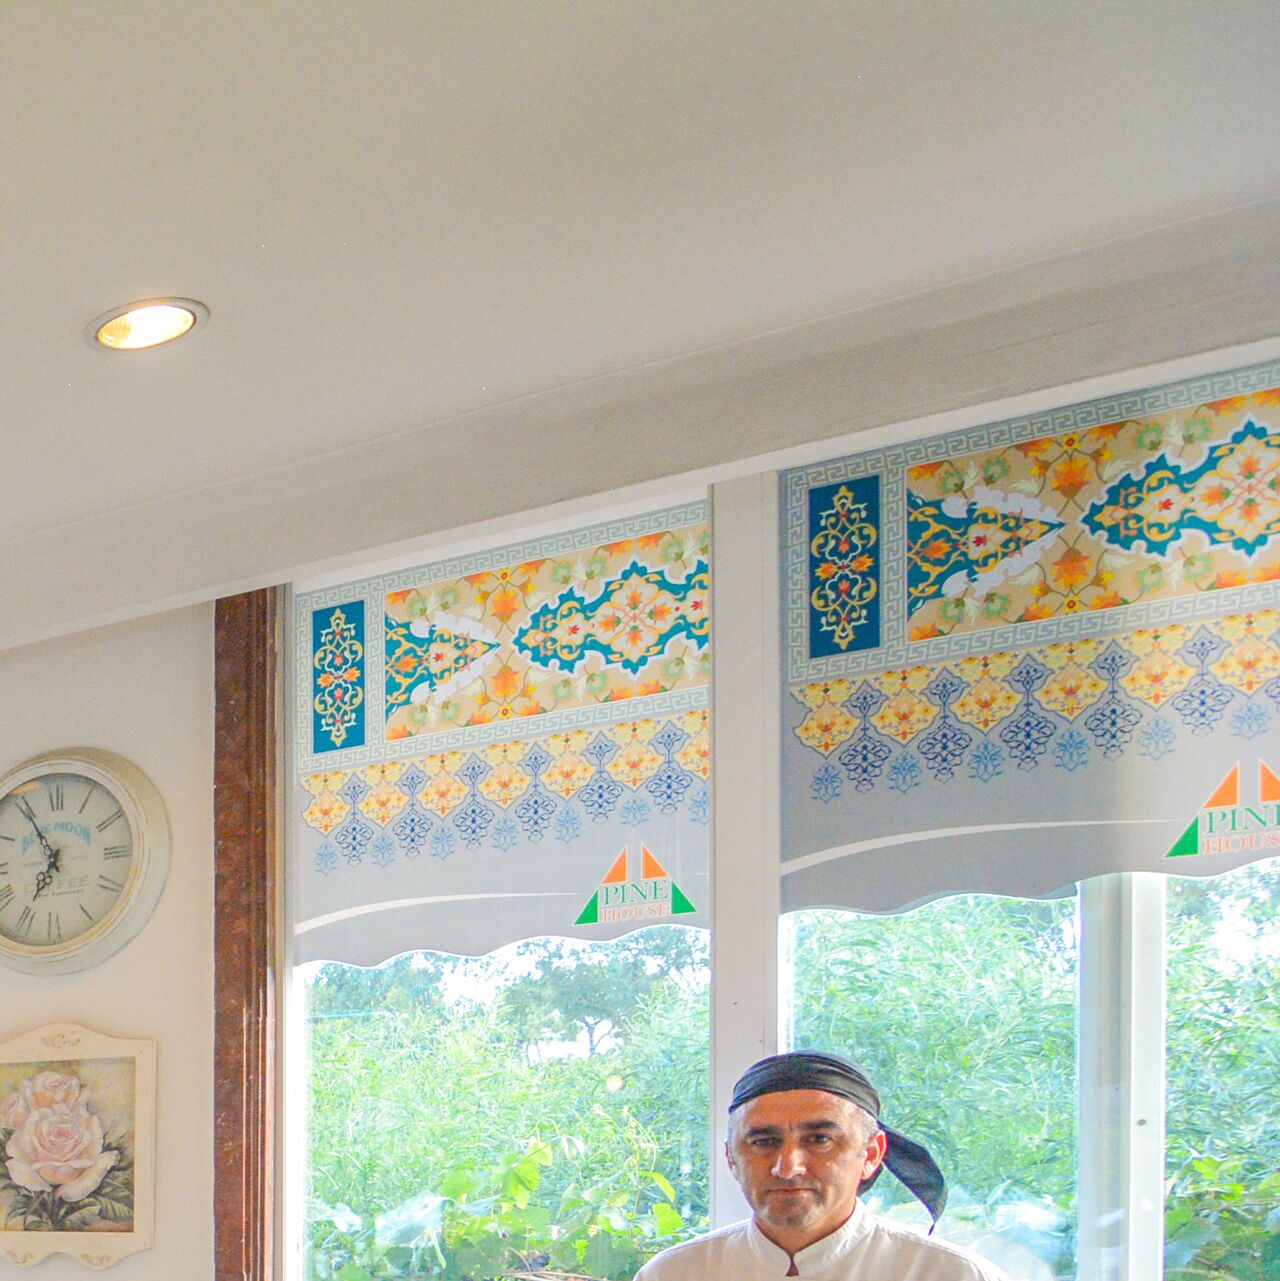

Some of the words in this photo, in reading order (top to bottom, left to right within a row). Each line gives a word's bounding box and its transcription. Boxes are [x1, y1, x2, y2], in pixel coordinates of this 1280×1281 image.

[54, 822, 91, 847] MOON
[1205, 832, 1280, 854] HOUS
[23, 876, 89, 892] CFFEE
[603, 880, 669, 905] PINE
[602, 903, 670, 921] HOUSE
